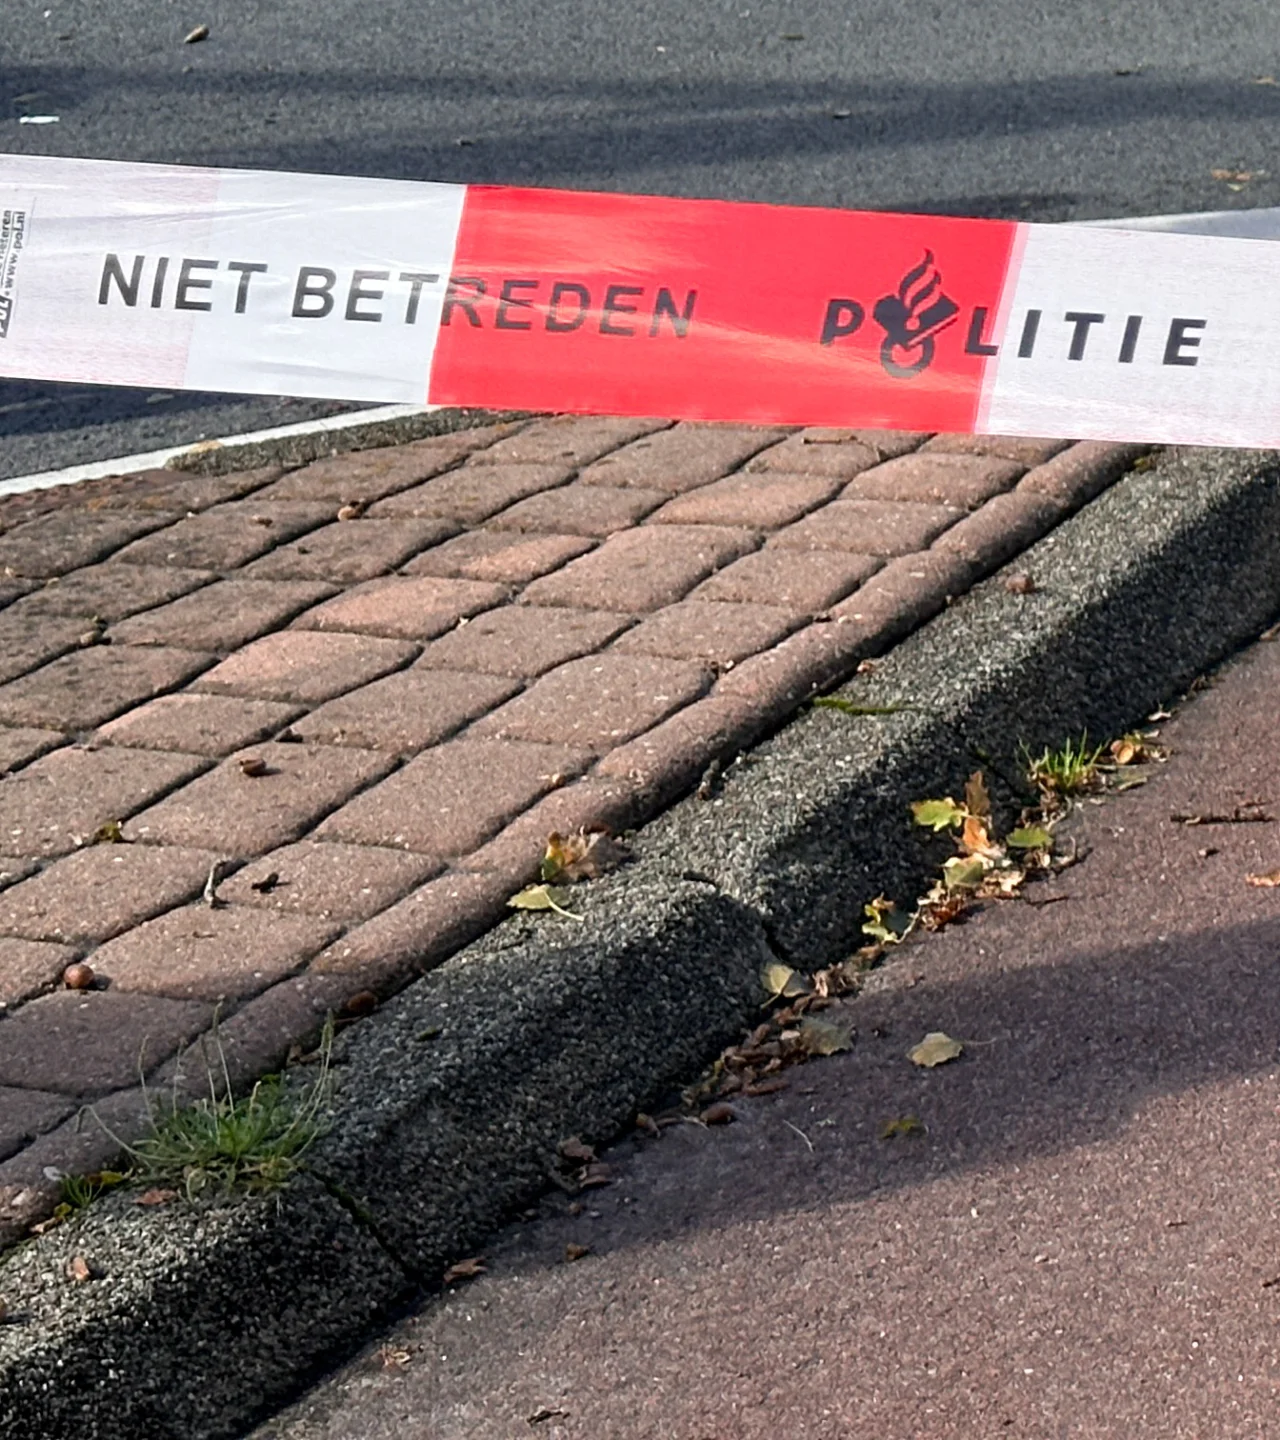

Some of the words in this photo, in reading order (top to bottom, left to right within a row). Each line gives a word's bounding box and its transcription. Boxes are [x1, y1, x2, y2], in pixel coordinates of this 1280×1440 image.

[99, 254, 268, 315] NIET
[292, 266, 698, 339] BETREDEN
[821, 250, 1208, 379] POLITIE
